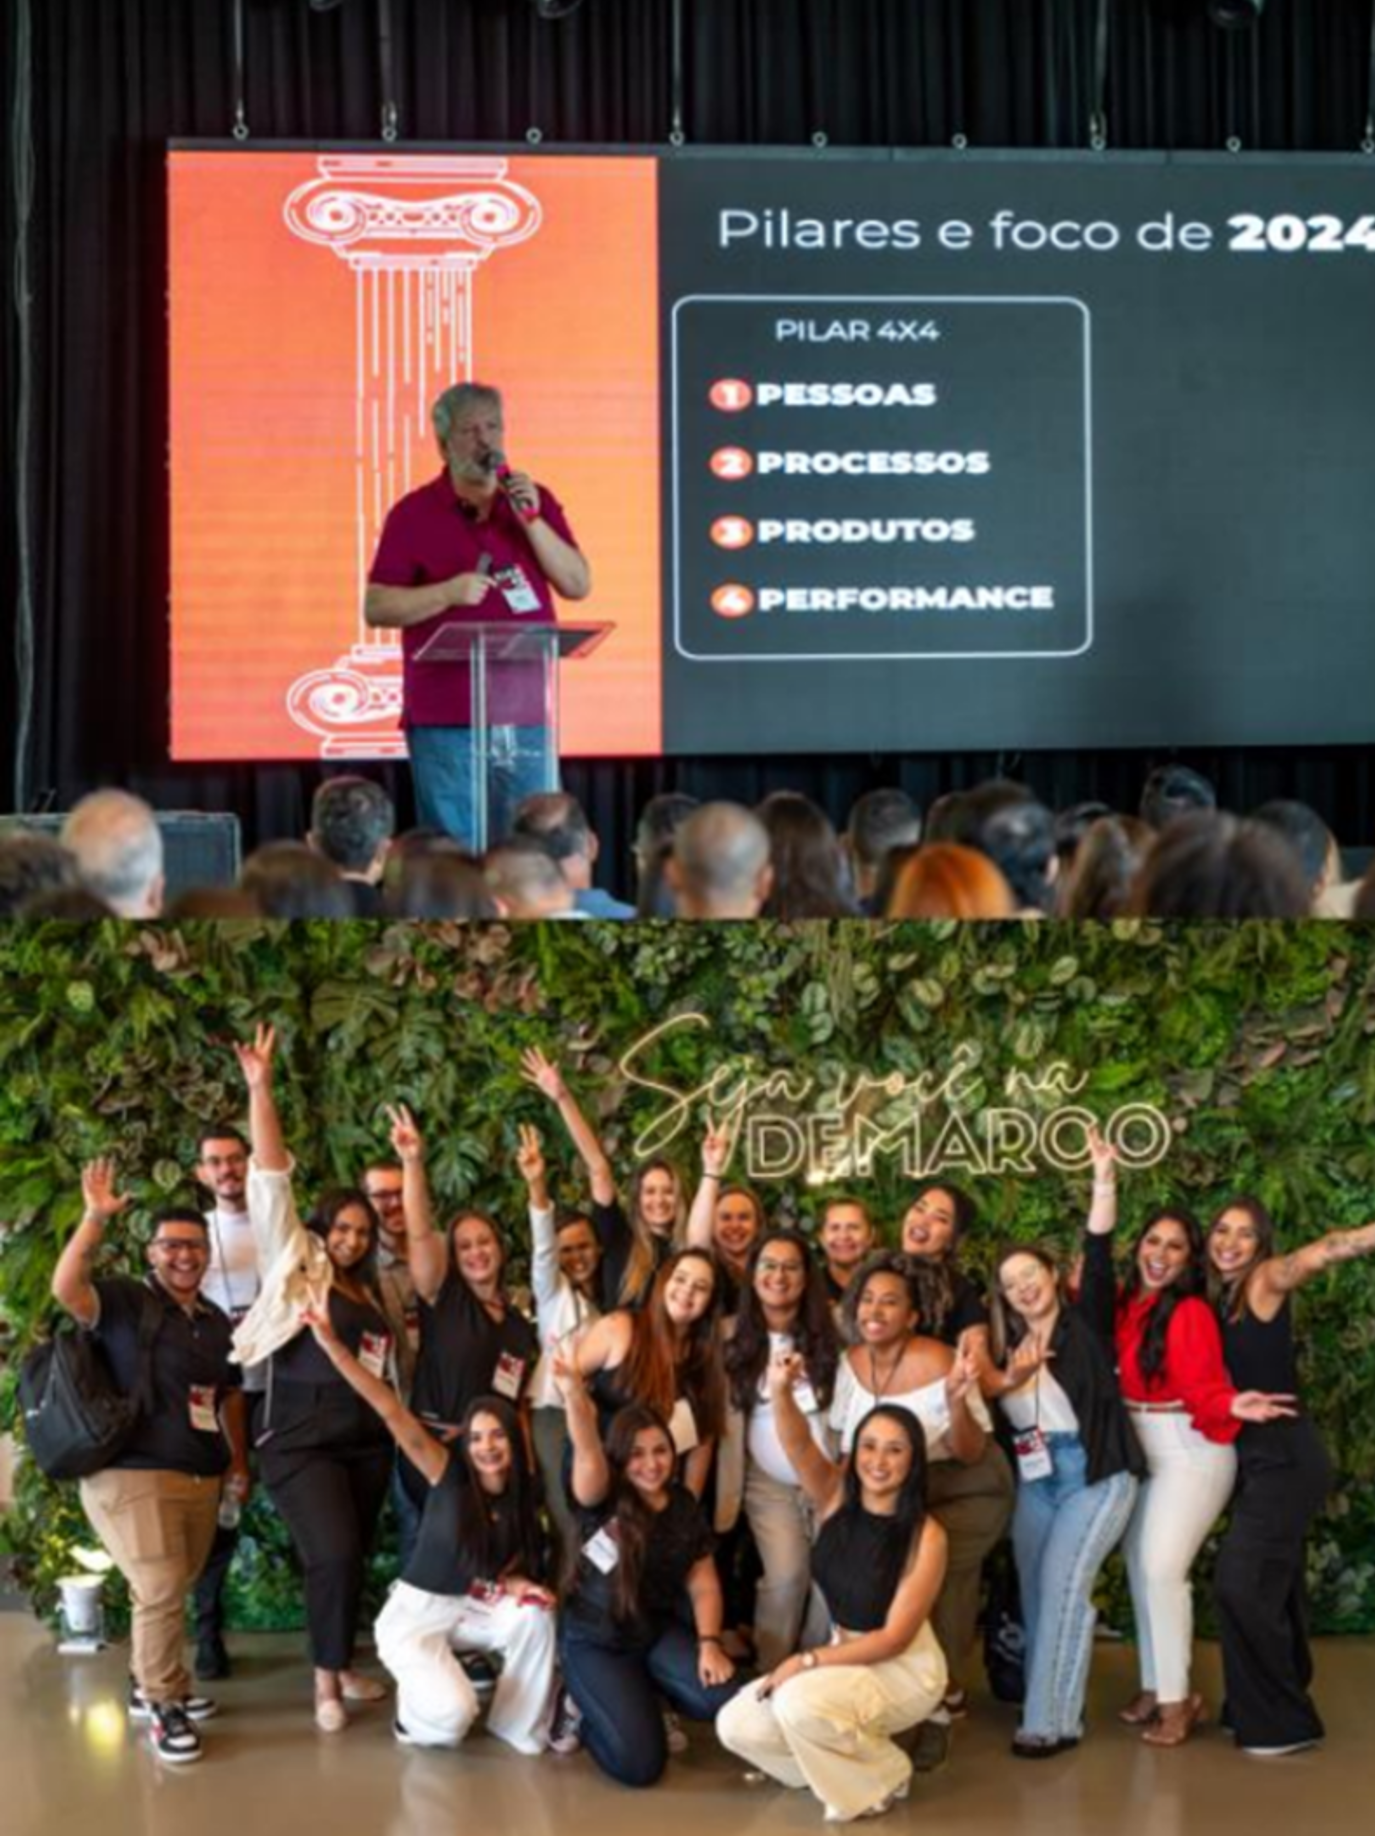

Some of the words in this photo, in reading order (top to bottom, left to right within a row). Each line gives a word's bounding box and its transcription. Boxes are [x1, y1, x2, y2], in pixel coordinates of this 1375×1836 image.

[721, 208, 920, 249] Pilares
[937, 219, 973, 249] e
[990, 210, 1119, 250] foco
[1136, 212, 1213, 251] de
[776, 320, 870, 341] PILAR
[877, 321, 940, 341] 4X4
[756, 382, 937, 407] PESSOAS
[756, 450, 991, 475] PROCESSOS
[757, 518, 976, 543] PRODUTOS
[719, 587, 748, 613] 4
[757, 585, 1055, 612] PERFORMANCE
[619, 1012, 813, 1174] Seja
[746, 1103, 1172, 1182] DEMARCO
